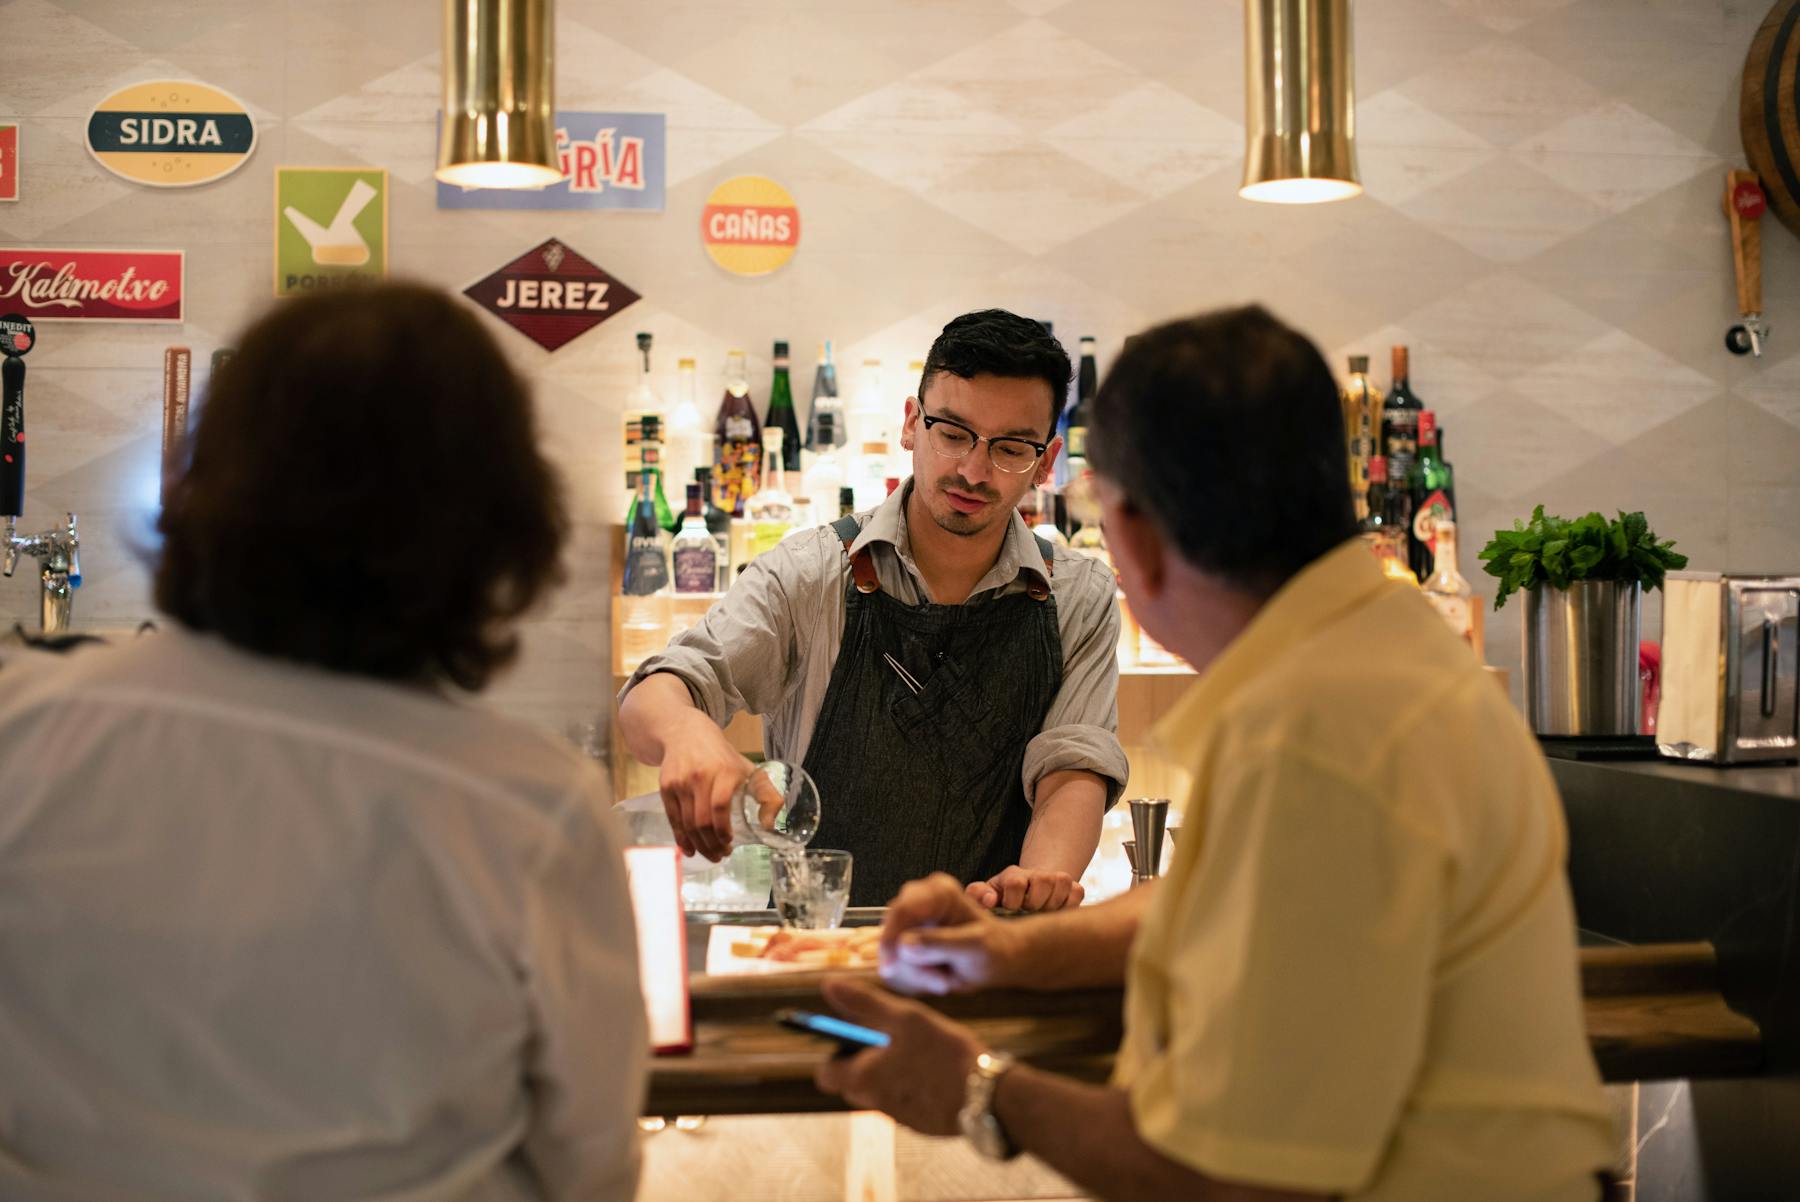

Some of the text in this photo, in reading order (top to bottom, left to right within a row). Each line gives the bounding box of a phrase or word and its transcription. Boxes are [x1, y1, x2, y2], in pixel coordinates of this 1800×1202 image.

[120, 118, 223, 147] SIDRA
[709, 209, 791, 242] CAÑAS
[0, 261, 169, 309] Kalimotxo
[497, 279, 610, 311] JEREZ
